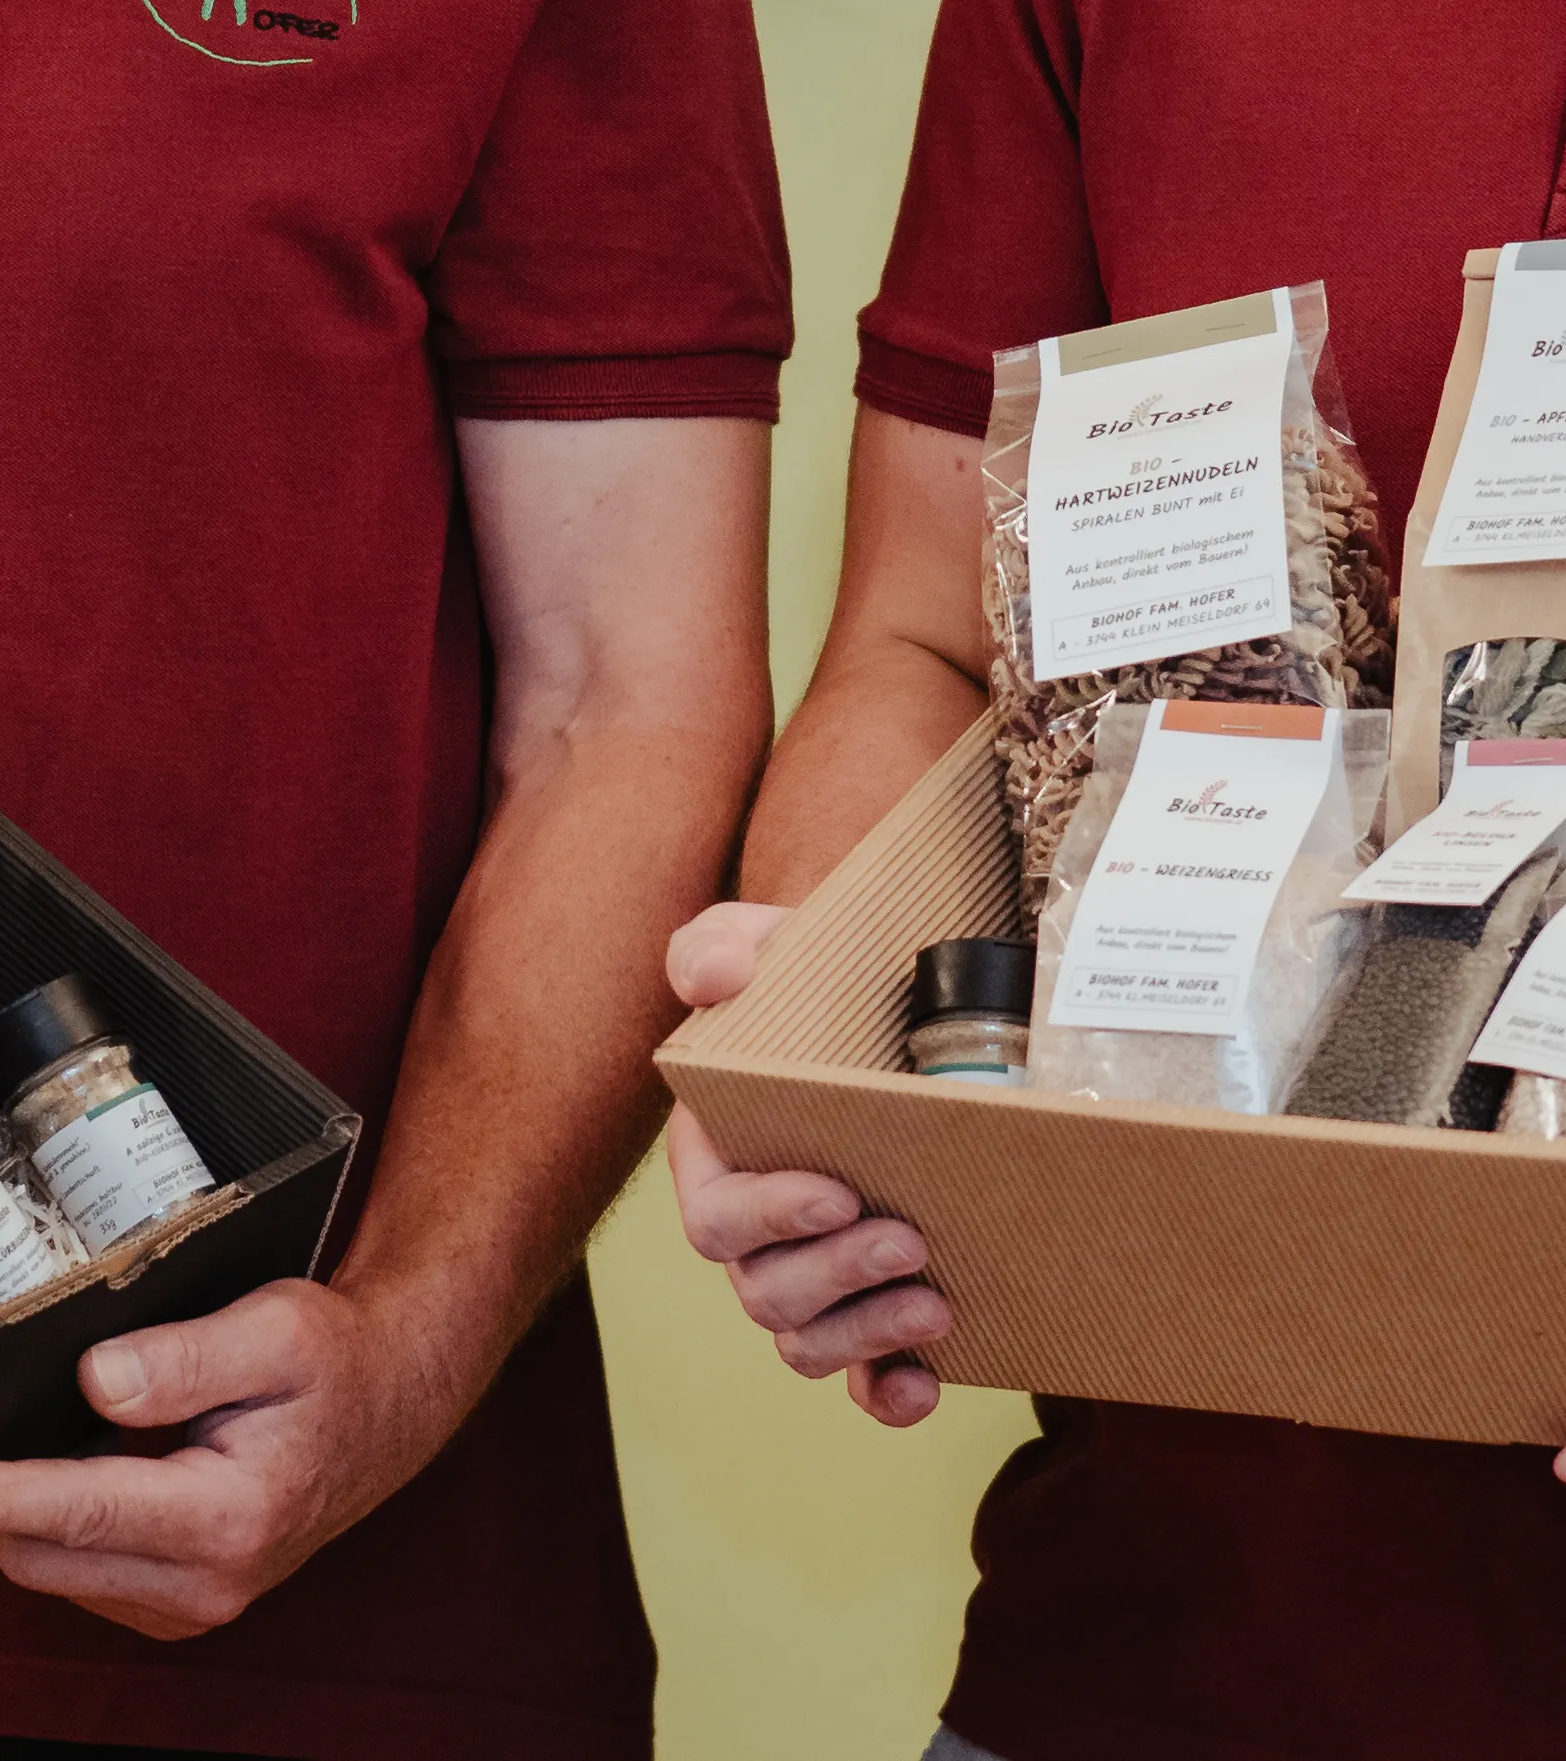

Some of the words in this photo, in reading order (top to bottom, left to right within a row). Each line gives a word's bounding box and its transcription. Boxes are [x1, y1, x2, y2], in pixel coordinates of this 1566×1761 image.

[1531, 340, 1563, 358] Bio
[1086, 420, 1133, 440] Bio
[1148, 398, 1233, 428] Taste
[1489, 414, 1517, 428] BIO
[1129, 456, 1163, 476] BIO
[1055, 456, 1260, 512] HARTWEIZENNUDELN
[1071, 506, 1146, 532] SPIRALEN
[1151, 496, 1194, 517] BUNT
[1198, 491, 1224, 507] mit
[1230, 487, 1245, 501] Ei
[1466, 518, 1514, 532] BIOHOF
[1065, 562, 1090, 576] Aus
[1095, 545, 1166, 572] kontrolliert
[1171, 529, 1254, 558] biologischem
[1072, 573, 1117, 592] Anbau,
[1122, 564, 1162, 583] direkt
[1165, 558, 1193, 572] vom
[1198, 545, 1250, 567] Bauern!
[1090, 607, 1143, 629] BIOHOF
[1149, 600, 1185, 618] FAM.
[1189, 588, 1236, 608] HOFER
[1121, 623, 1163, 641] KLEIN
[1166, 601, 1250, 633] MEISELDORF
[1166, 798, 1200, 814] Bio
[1209, 801, 1268, 821] Taste
[1106, 862, 1135, 875] BIO
[1154, 863, 1275, 883] WEIZENGRIESS
[131, 1114, 149, 1129] Bio
